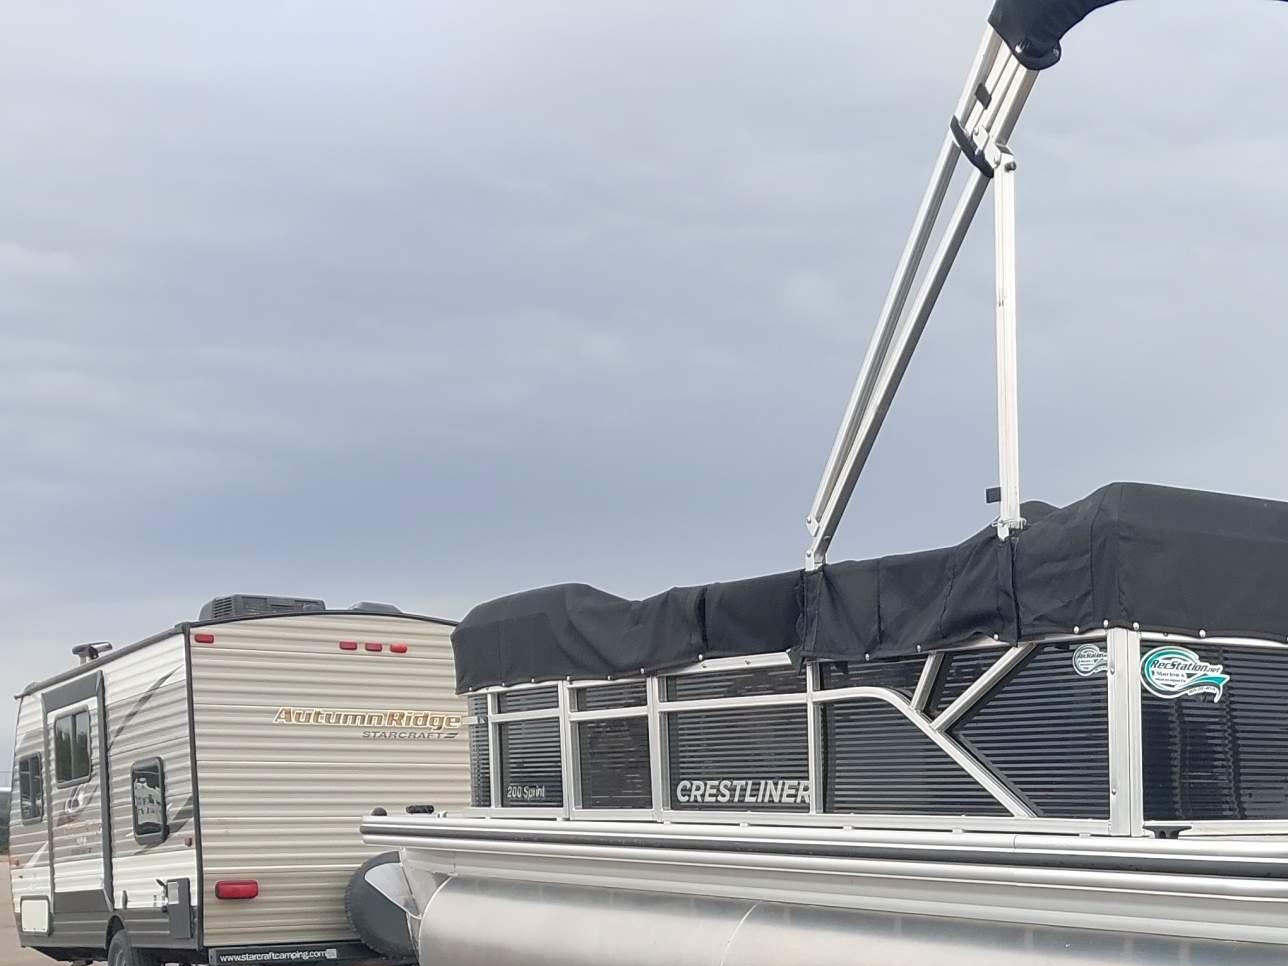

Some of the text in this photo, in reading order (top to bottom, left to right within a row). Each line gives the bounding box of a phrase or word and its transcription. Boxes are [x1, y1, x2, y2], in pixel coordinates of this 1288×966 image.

[273, 707, 462, 730] Autumn Ridge
[362, 730, 442, 739] STARCRAFT
[507, 785, 522, 798] 200
[676, 780, 811, 804] CRESTLINER
[220, 950, 327, 963] www.starcraftcamping.com
